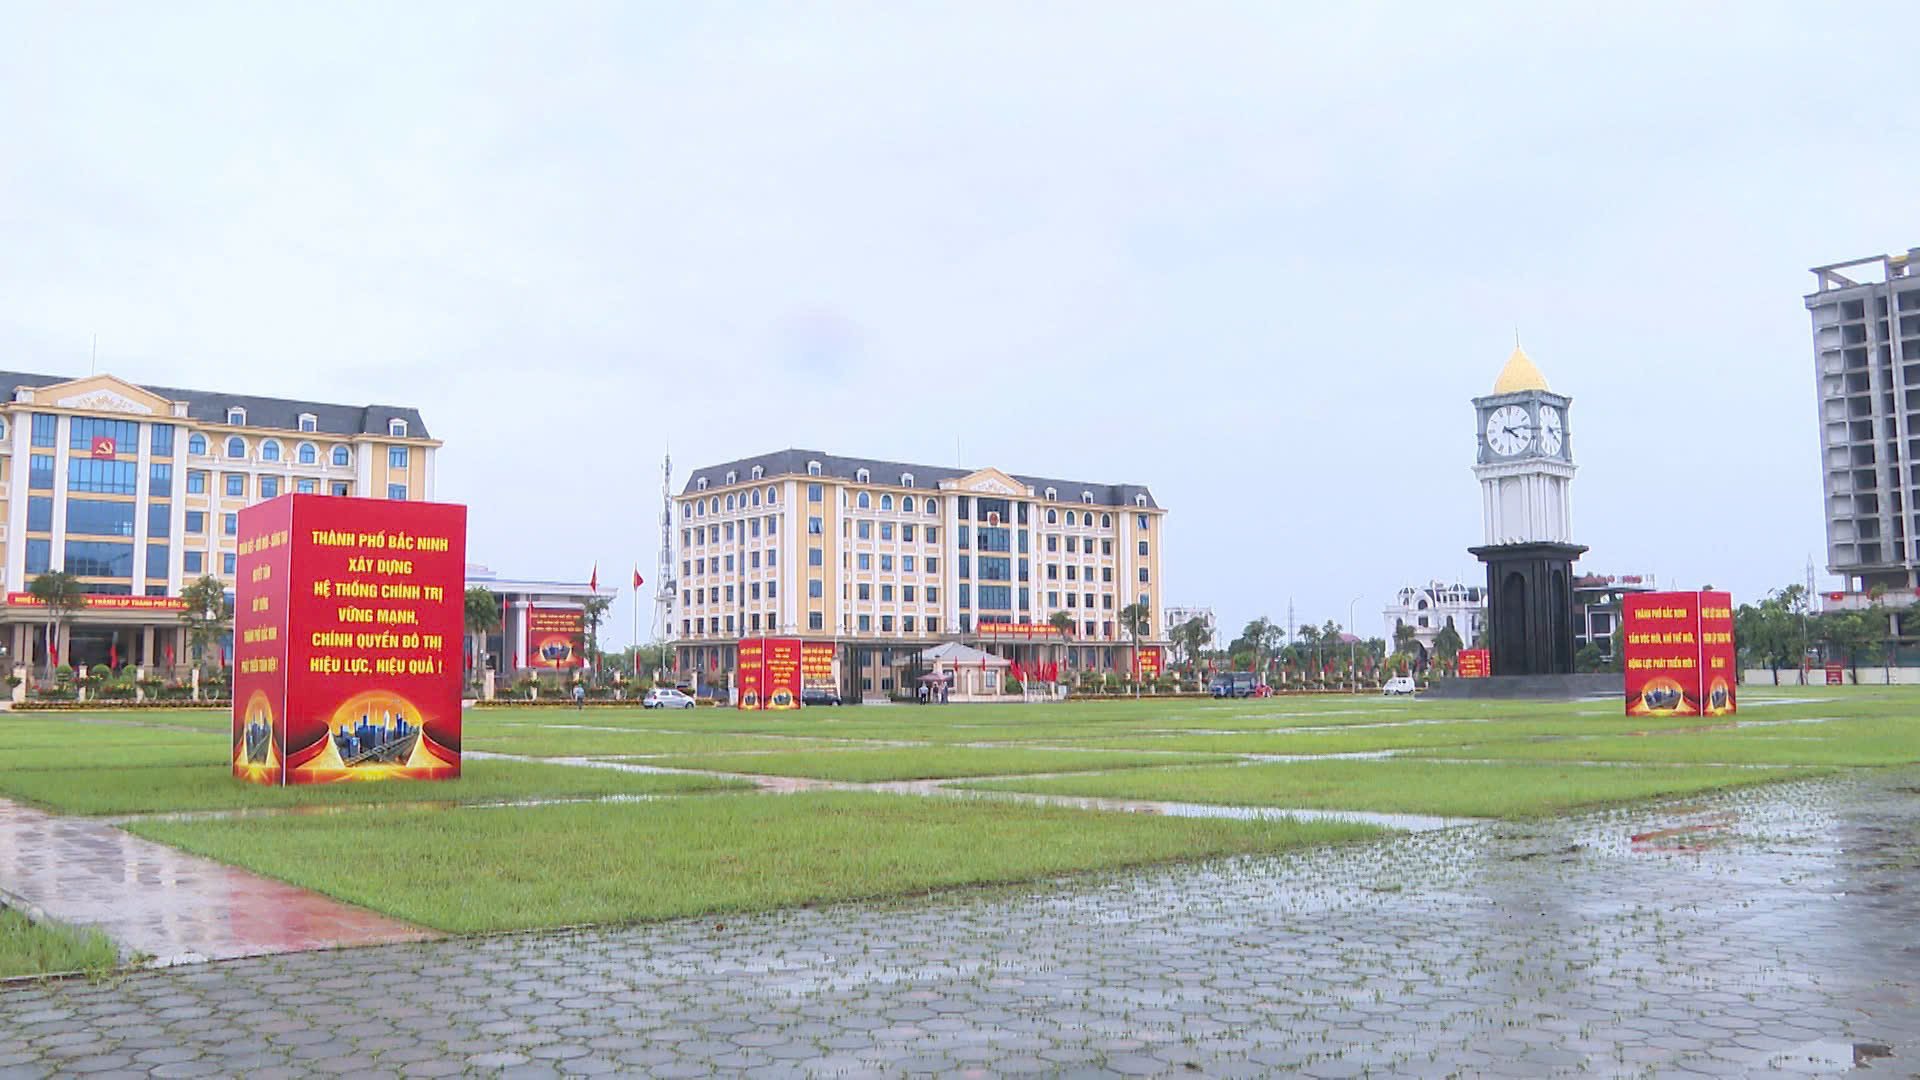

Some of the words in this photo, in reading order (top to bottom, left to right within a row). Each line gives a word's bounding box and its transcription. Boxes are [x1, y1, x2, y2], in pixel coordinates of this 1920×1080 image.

[312, 529, 355, 546] THÀNH
[358, 530, 385, 547] PHỐ
[388, 531, 414, 548] BẮC
[417, 537, 448, 551] NINH
[348, 556, 373, 572] XÂY
[377, 560, 412, 576] DỰNG
[314, 580, 331, 597] HỆ
[335, 578, 377, 597] THỐNG
[381, 584, 420, 600] CHÍNH
[424, 587, 443, 603] TRỊ
[338, 605, 373, 622] VỮNG
[377, 609, 418, 626] MẠNH,
[312, 630, 352, 647] CHÍNH
[402, 633, 419, 648] ĐÔ
[423, 635, 442, 651] THỊ
[310, 656, 340, 675] HIỆU
[344, 658, 373, 675] LỰC,
[376, 657, 405, 675] HIỆU
[409, 656, 434, 674] QUẢ
